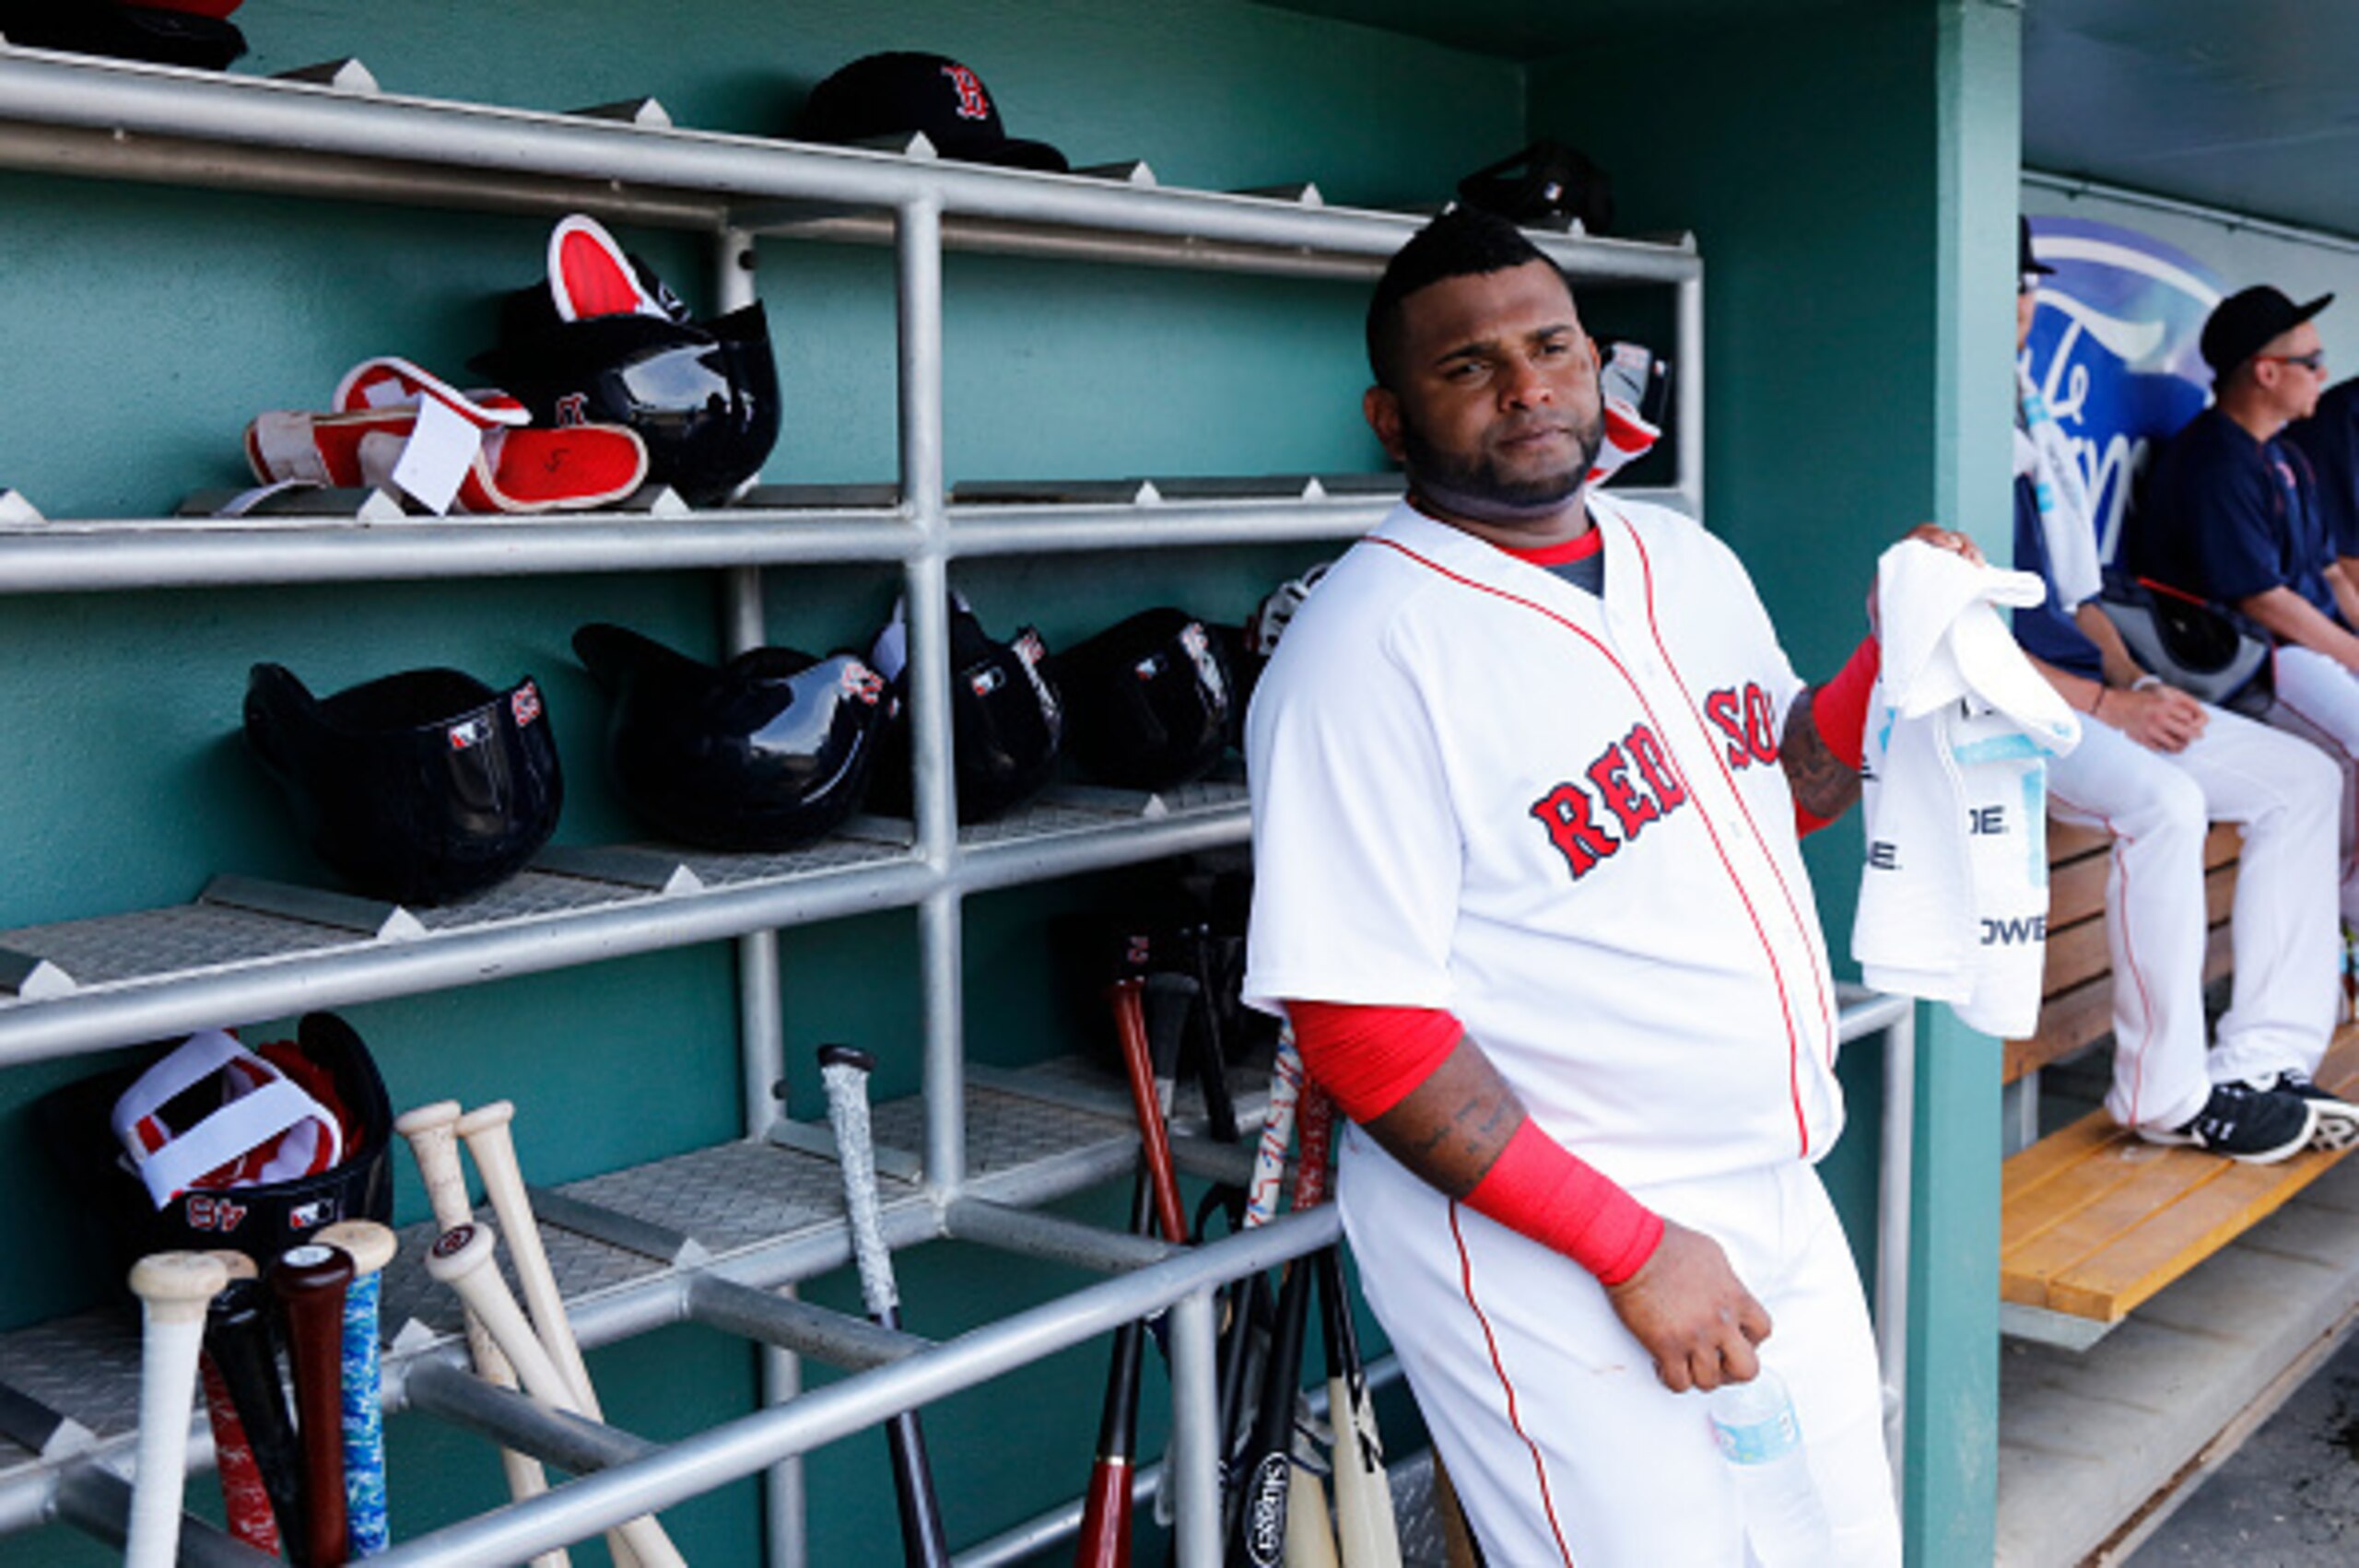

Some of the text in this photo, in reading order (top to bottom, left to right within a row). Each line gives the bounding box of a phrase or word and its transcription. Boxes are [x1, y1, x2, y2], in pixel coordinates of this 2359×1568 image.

[941, 64, 989, 121] B
[1529, 680, 1779, 882] RED SO
